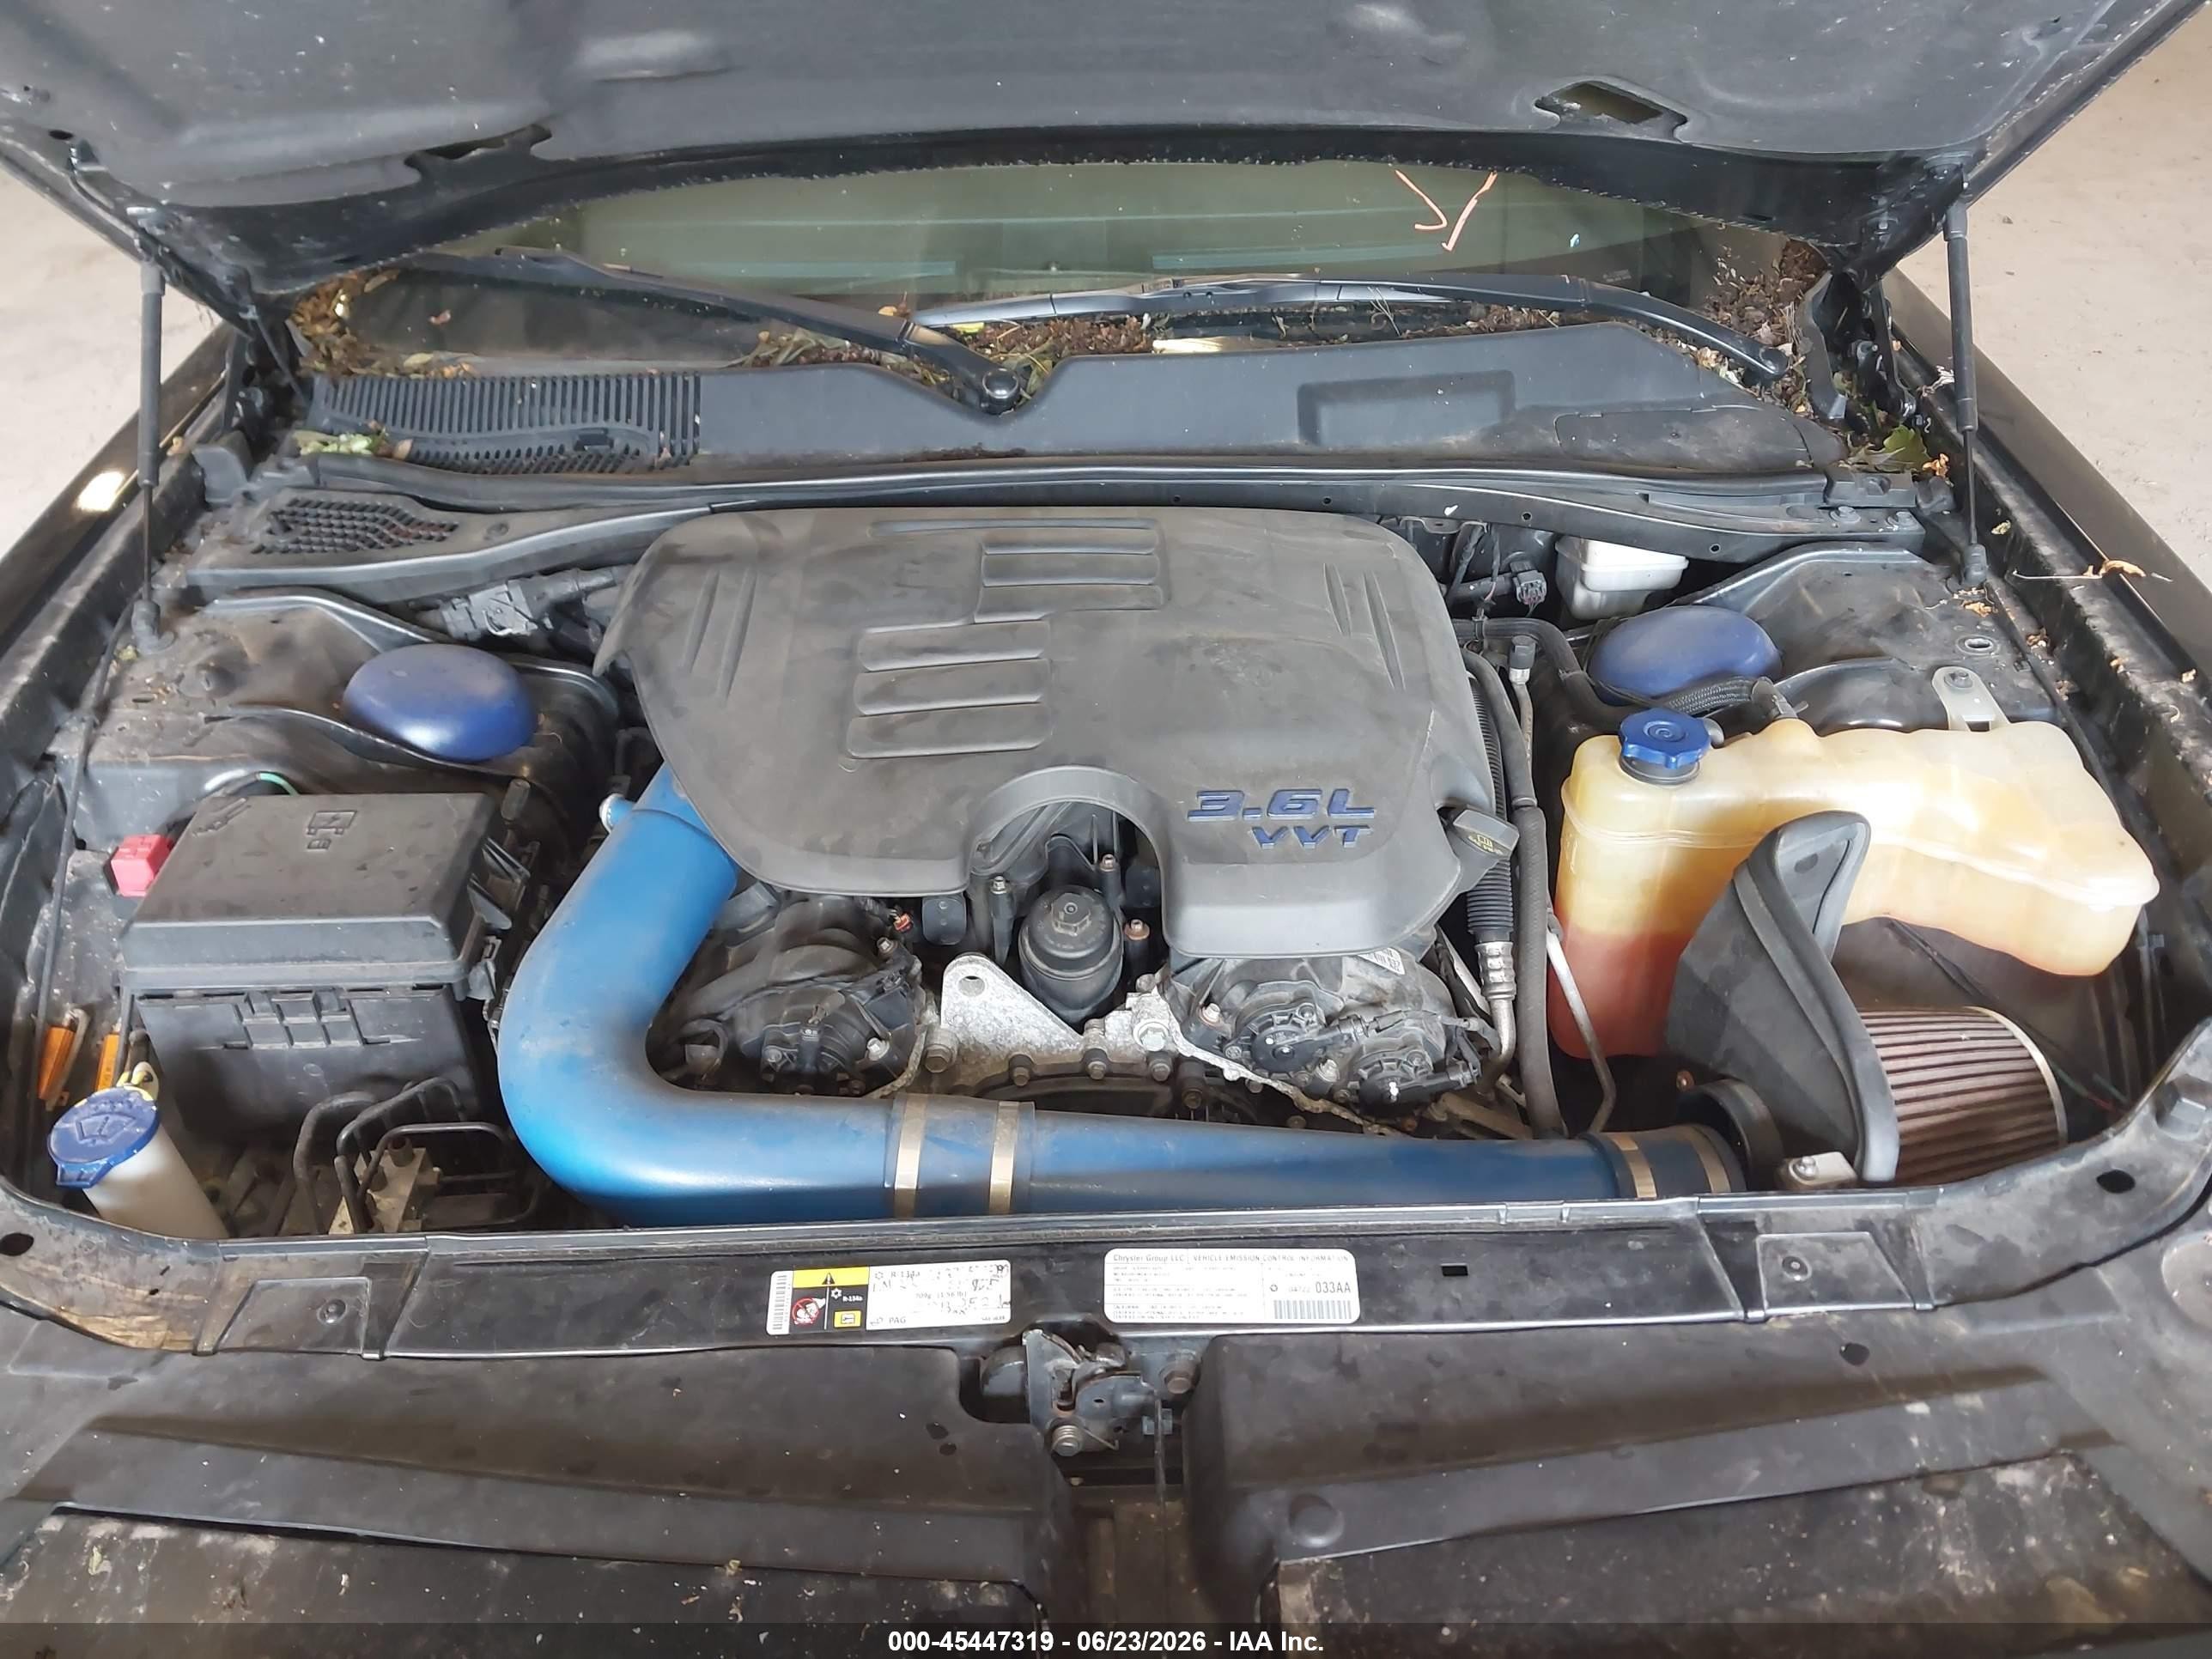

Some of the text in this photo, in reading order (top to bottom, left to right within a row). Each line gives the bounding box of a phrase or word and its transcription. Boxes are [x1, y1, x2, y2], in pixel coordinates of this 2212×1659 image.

[1188, 788, 1375, 822] 3.6L
[1249, 824, 1374, 849] VVT
[1114, 1254, 1184, 1263] Chrysler Group LLC
[1299, 1254, 1348, 1262] INFORMATON
[1315, 1280, 1351, 1293] 033AA
